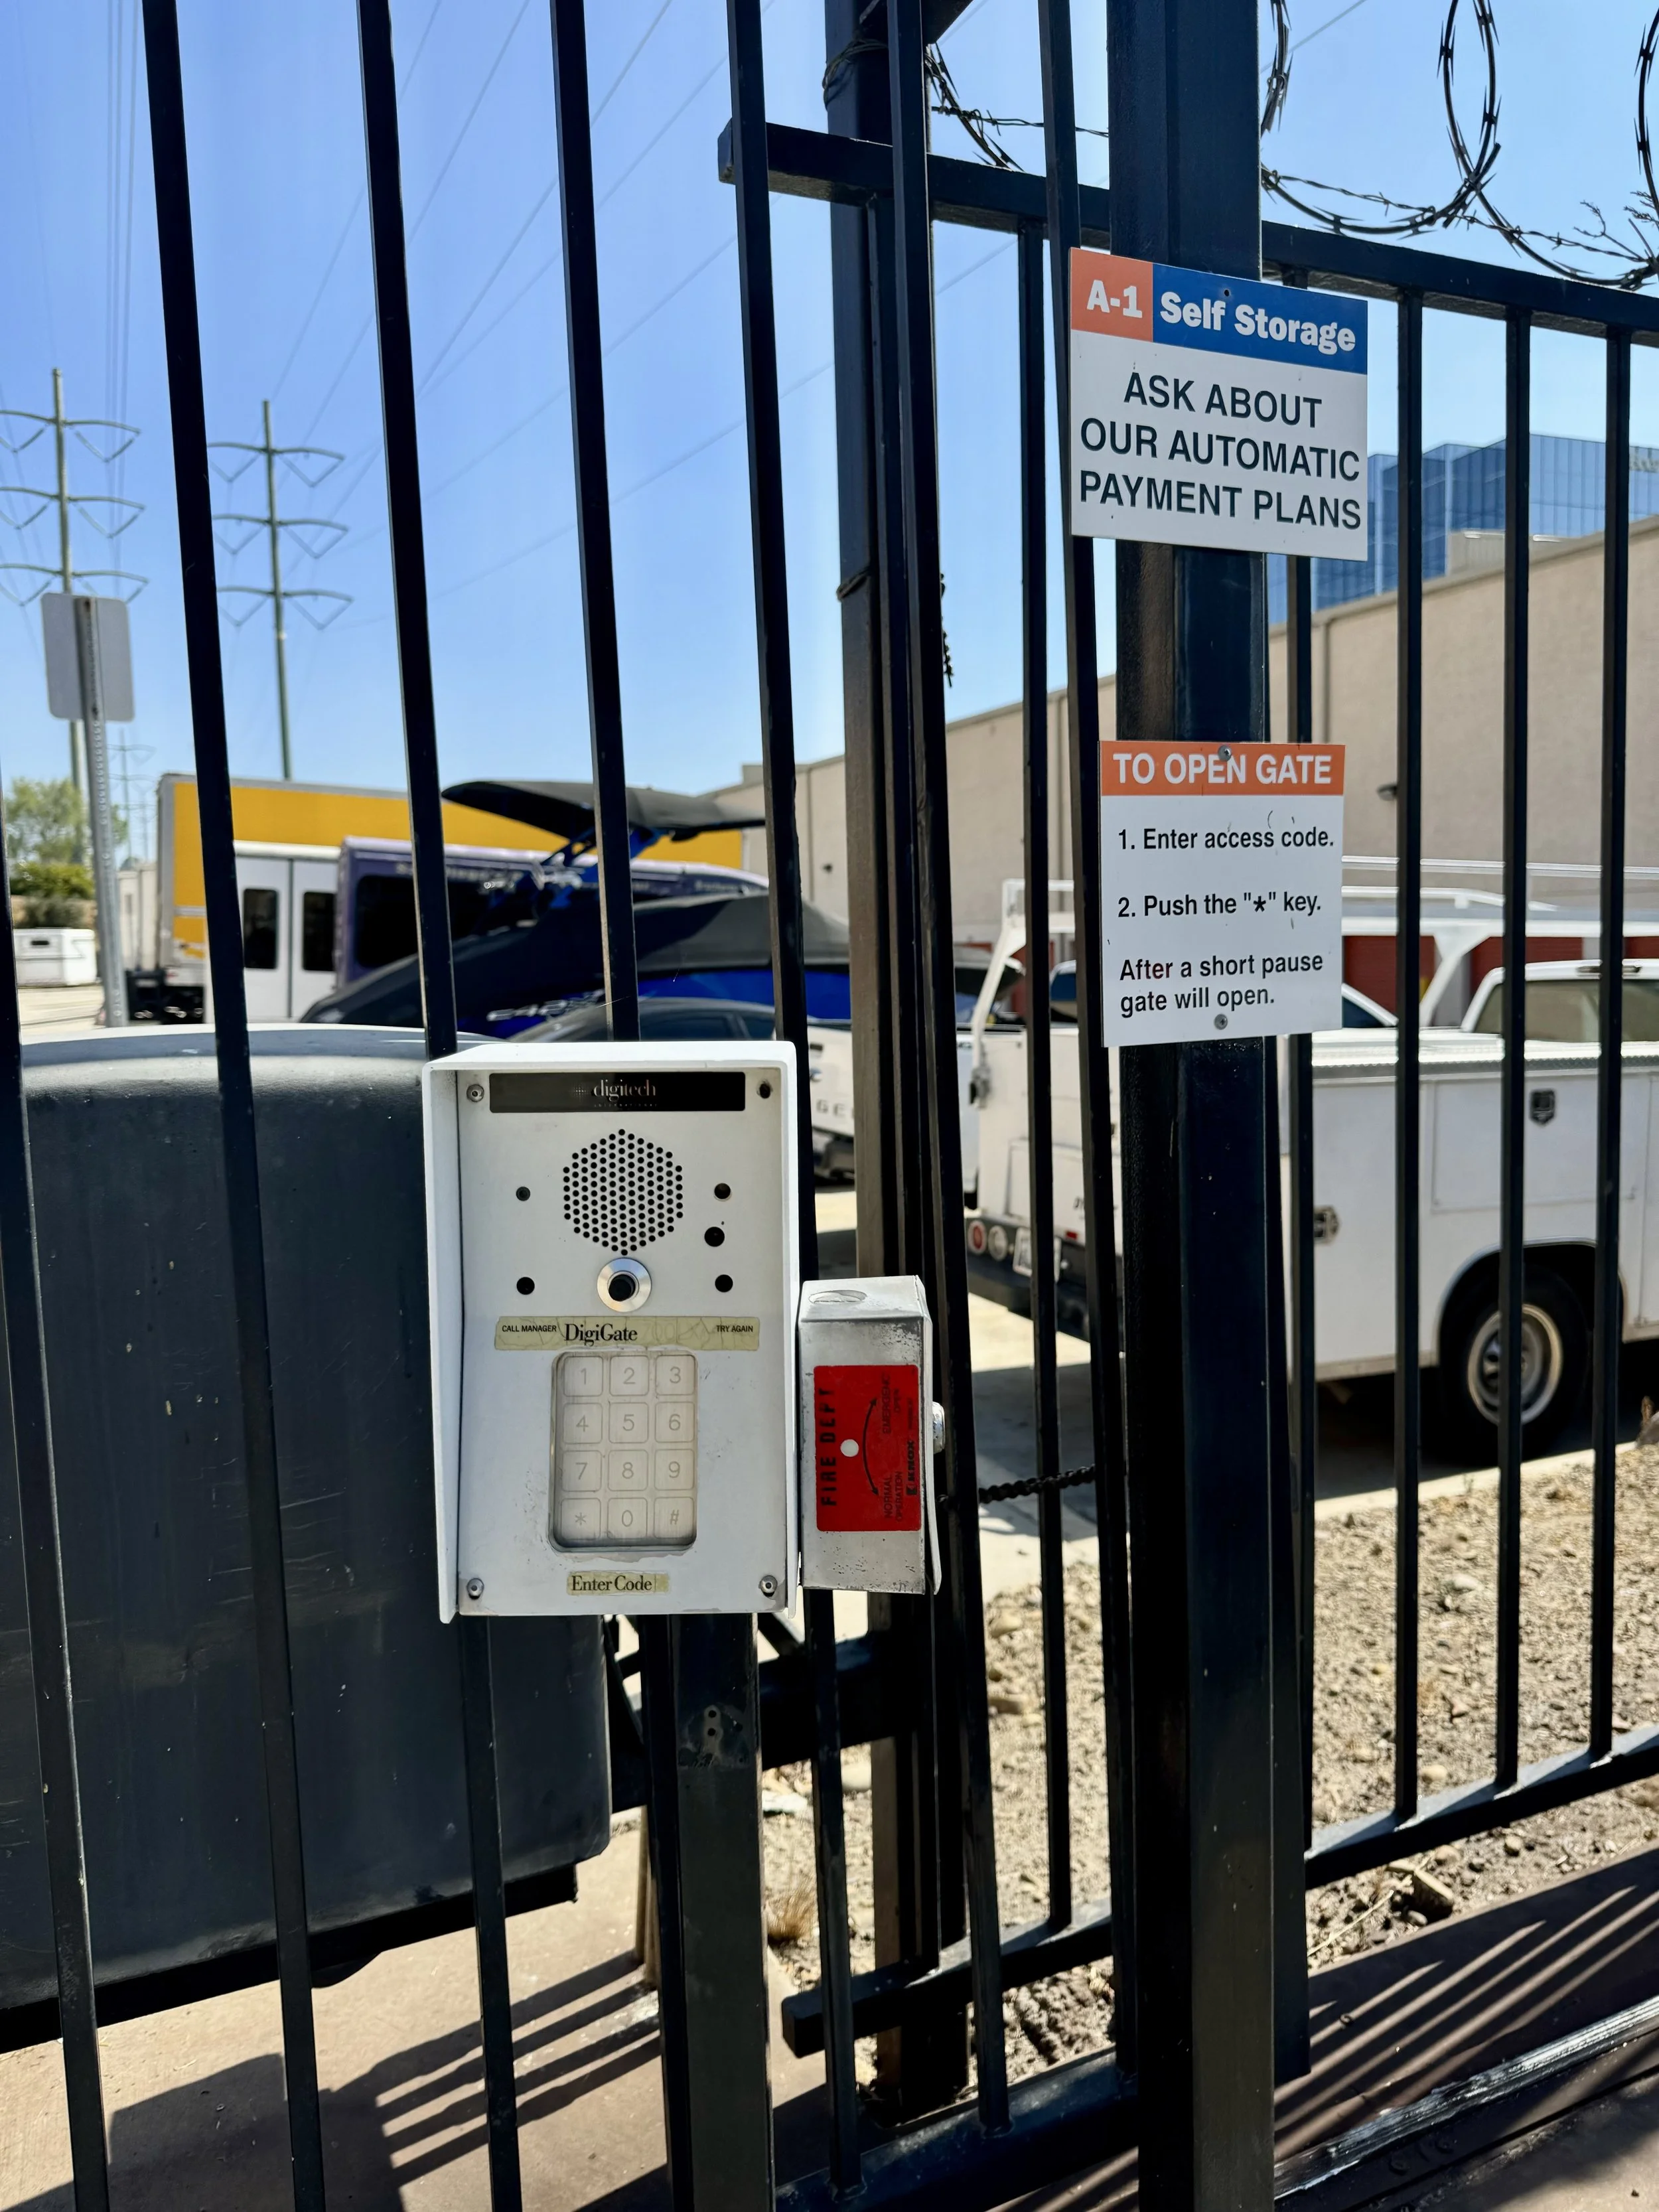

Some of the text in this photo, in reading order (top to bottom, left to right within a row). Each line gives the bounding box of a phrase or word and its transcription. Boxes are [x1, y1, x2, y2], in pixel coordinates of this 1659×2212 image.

[1086, 279, 1356, 355] A-1 Self Storage
[1124, 372, 1322, 428] ASK ABOUT
[1080, 417, 1360, 482] OUR AUTOMATIC
[1080, 469, 1361, 530] PAYMENT PLANS
[1113, 753, 1332, 784] TO OPEN GATE
[1118, 826, 1334, 849] 1. Enter access code.
[1118, 897, 1136, 917] 2.
[1143, 895, 1197, 916] Push
[1204, 894, 1237, 914] the
[1283, 891, 1321, 916] key.
[1120, 954, 1323, 980] After a short pause
[1120, 987, 1275, 1017] gate will open.
[593, 1079, 656, 1102] digitech
[564, 1323, 638, 1347] DigiGate
[580, 1368, 587, 1384] 1
[624, 1367, 635, 1384] 2
[669, 1366, 682, 1384] 3
[576, 1416, 589, 1432] 4
[622, 1414, 635, 1432] 5
[668, 1414, 682, 1432] 6
[819, 1388, 837, 1506] FIRE DEPT
[575, 1462, 589, 1480] 7
[621, 1461, 634, 1479] 8
[668, 1461, 681, 1479] 9
[884, 1473, 893, 1518] NORMAL
[895, 1471, 903, 1522] OPERATION
[621, 1509, 634, 1526] 0
[571, 1575, 652, 1591] Enter Code
